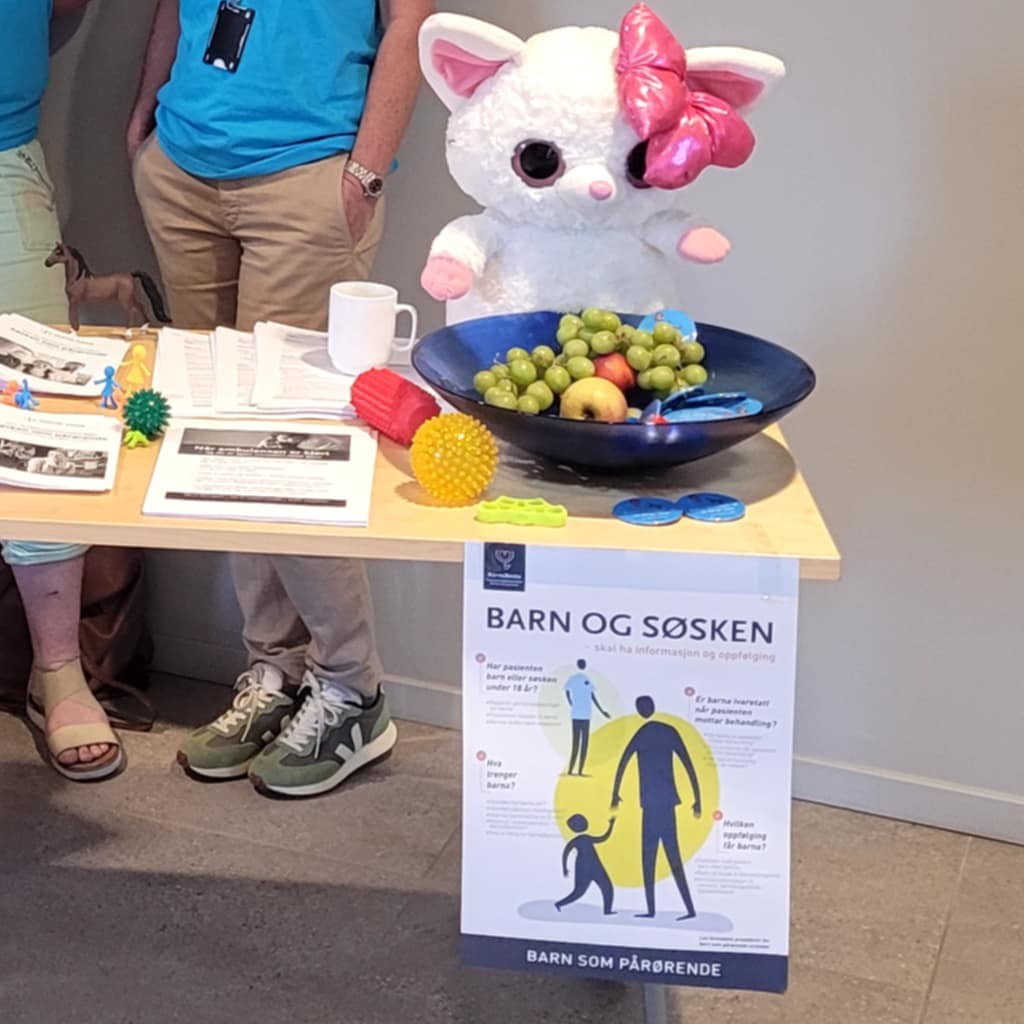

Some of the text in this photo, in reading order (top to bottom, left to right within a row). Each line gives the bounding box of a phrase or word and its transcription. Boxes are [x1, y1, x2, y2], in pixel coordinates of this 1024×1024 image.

[486, 607, 773, 644] BARN OG SØSKEN
[526, 950, 721, 977] BARN SOM PÅRØRENDE
